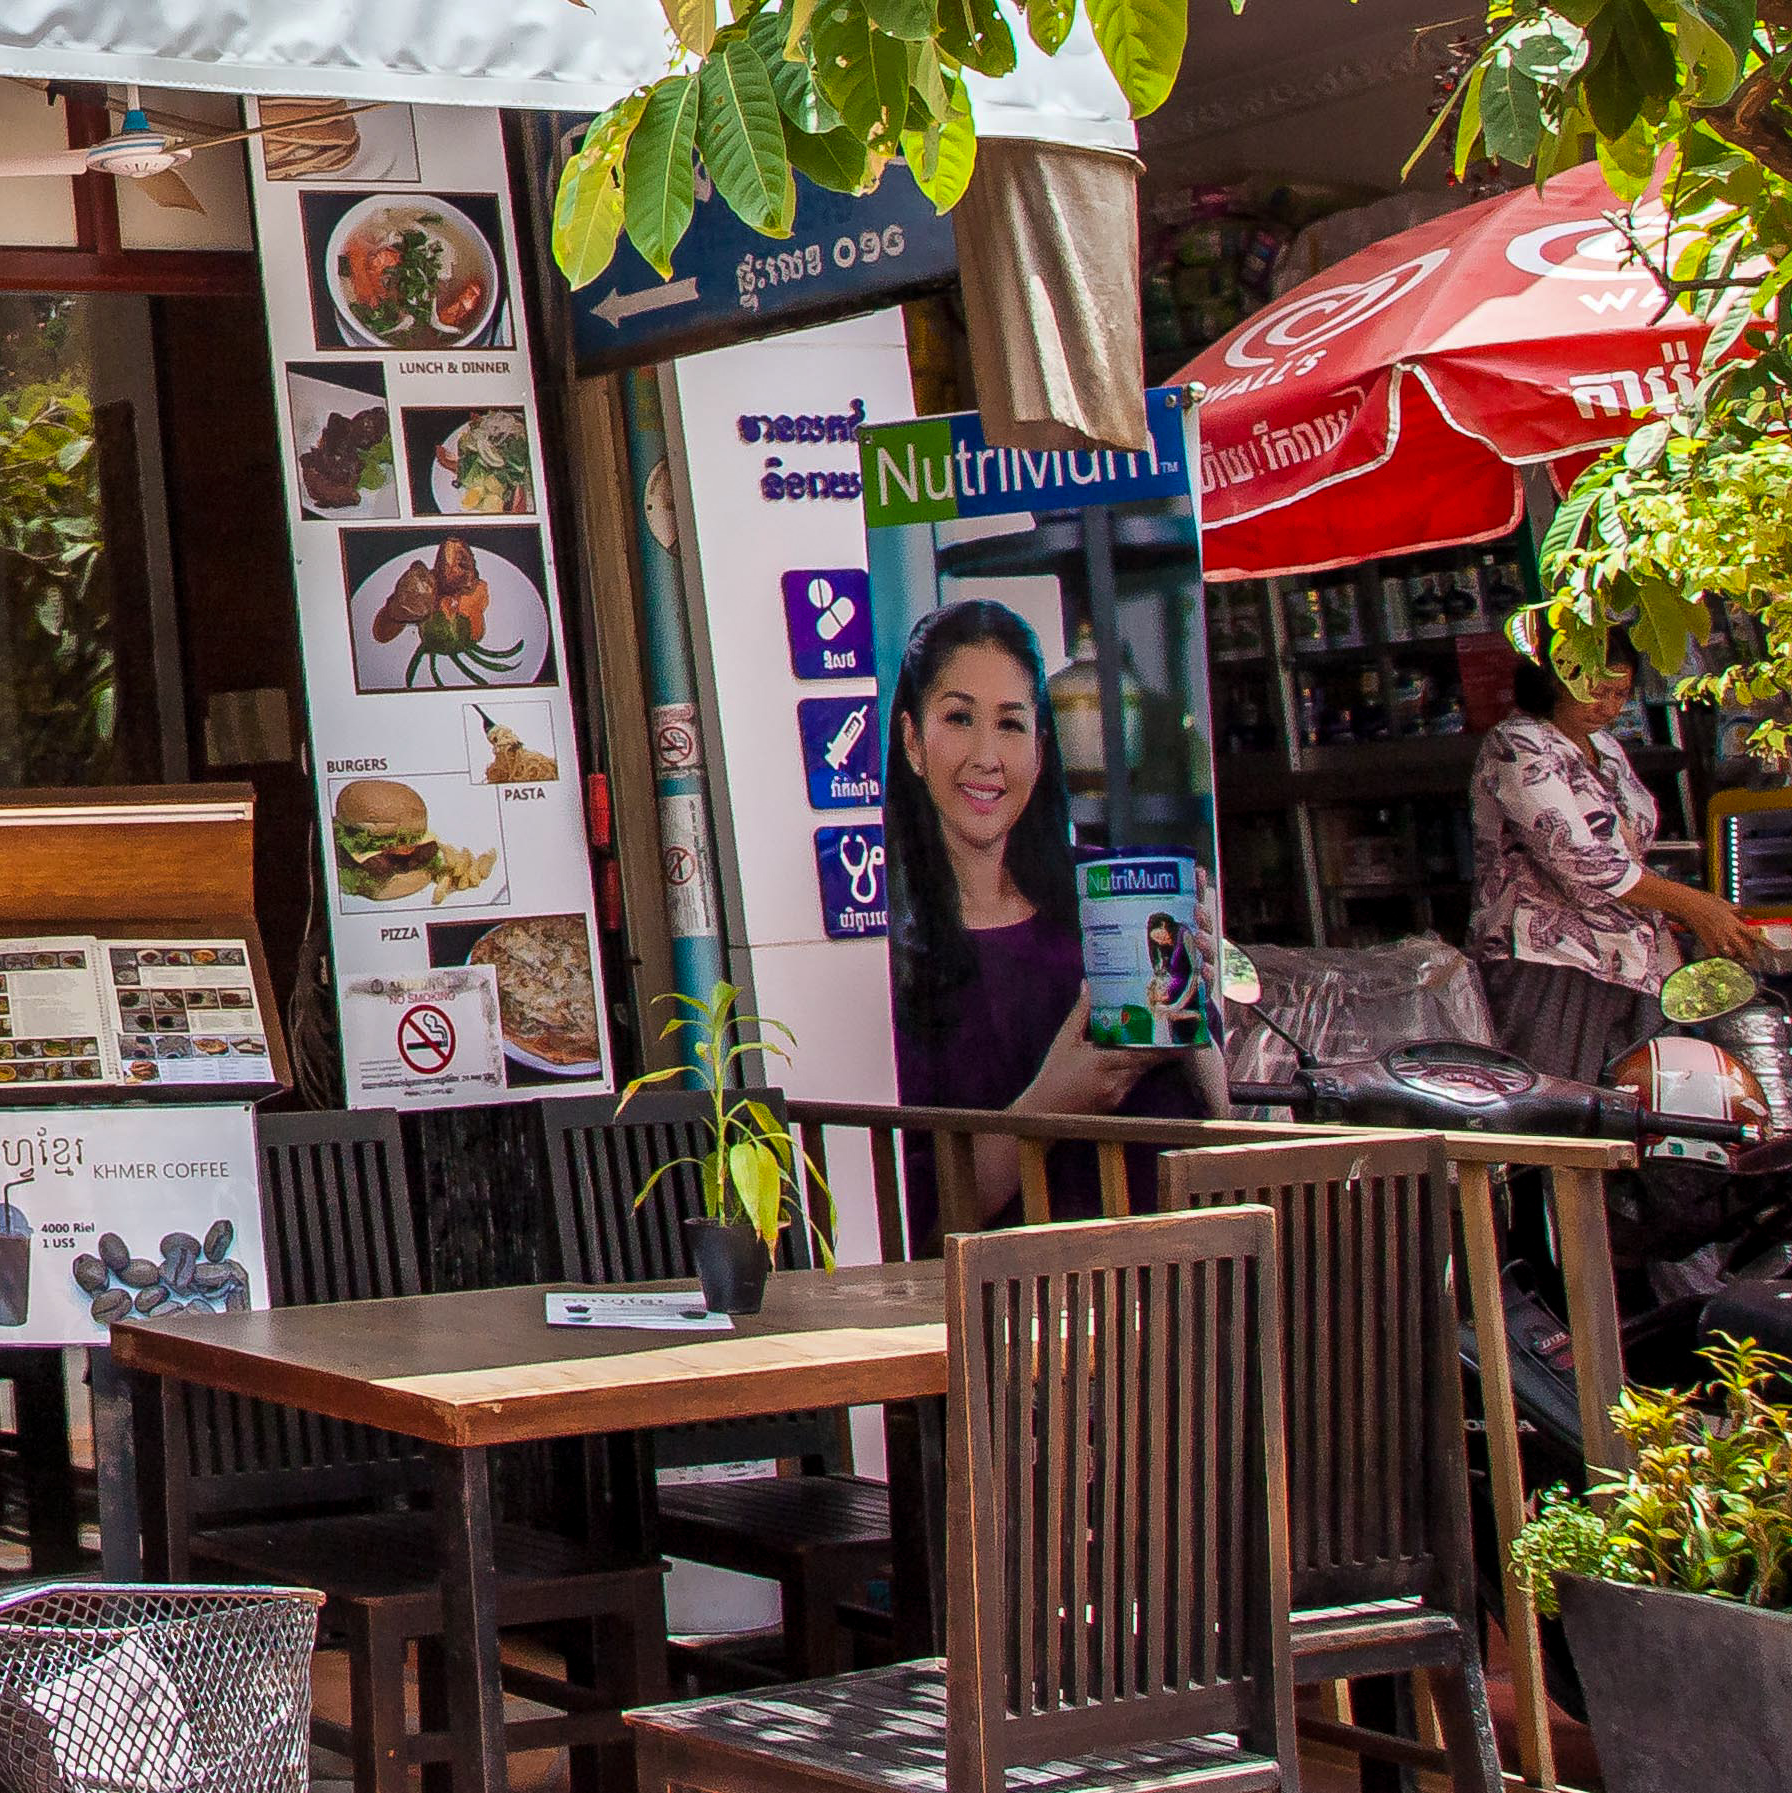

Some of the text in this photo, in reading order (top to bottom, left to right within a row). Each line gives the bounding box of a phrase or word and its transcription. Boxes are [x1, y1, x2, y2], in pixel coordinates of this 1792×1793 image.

[399, 360, 511, 374] LUNCH & DINNER
[326, 757, 388, 773] BURGERS
[504, 787, 546, 802] PASTA
[1088, 868, 1176, 892] NutriMum
[381, 926, 420, 942] PIZZA
[389, 991, 456, 1005] NO SMOKING
[93, 1161, 230, 1179] KHMER COFFEE
[41, 1221, 95, 1233] 4000 Riel
[52, 1237, 76, 1249] US$
